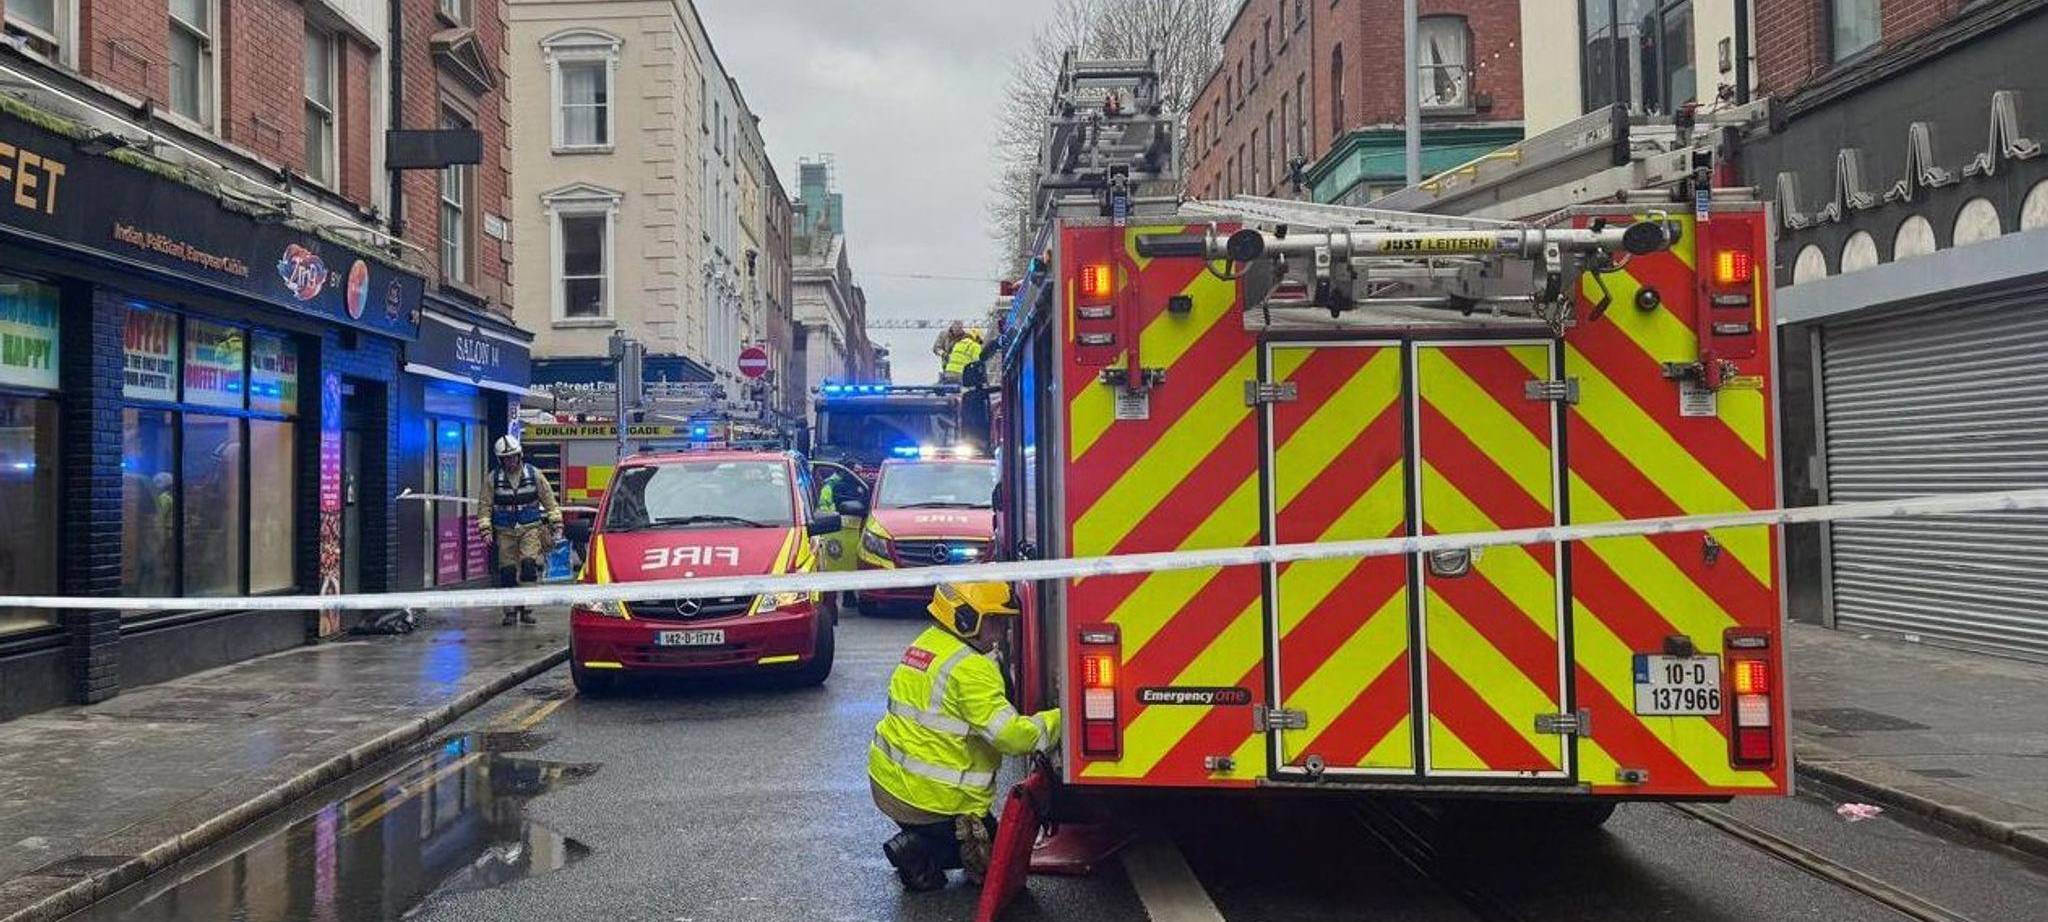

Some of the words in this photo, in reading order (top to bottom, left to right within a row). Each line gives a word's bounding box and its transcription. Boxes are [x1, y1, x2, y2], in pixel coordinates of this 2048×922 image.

[1382, 239, 1422, 250] JUST
[1428, 238, 1489, 249] LEITERN
[535, 427, 577, 436] DUBLIN
[581, 427, 607, 436] FIRE
[1665, 663, 1705, 684] 10-D
[1143, 690, 1214, 704] Emergency
[1652, 688, 1720, 710] 137966
